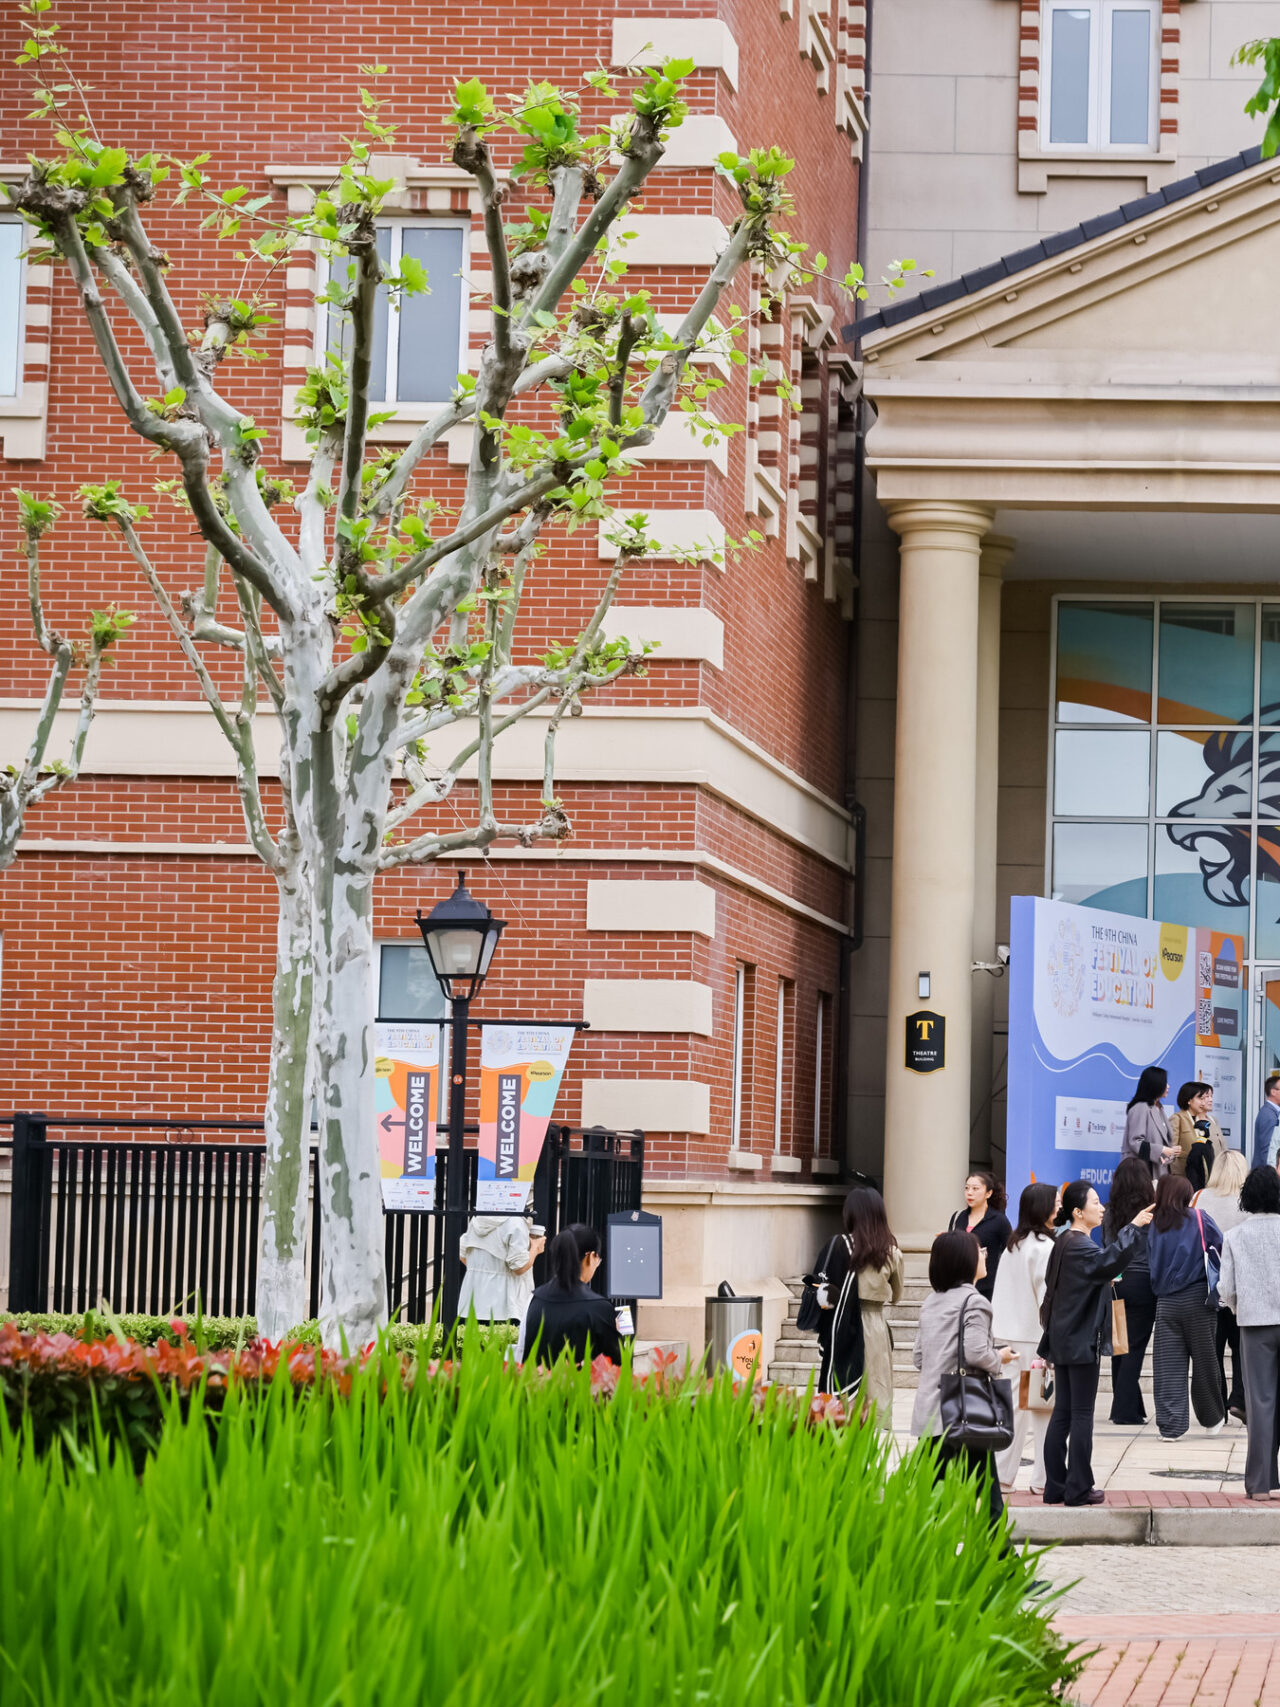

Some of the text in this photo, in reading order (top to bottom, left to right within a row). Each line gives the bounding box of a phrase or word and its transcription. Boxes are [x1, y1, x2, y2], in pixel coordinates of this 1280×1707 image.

[1092, 926, 1138, 946] THE 9TH CHINA
[1143, 952, 1157, 979] OF
[1164, 948, 1184, 963] Pearson
[1091, 973, 1154, 1009] EDUCATION
[916, 1020, 934, 1040] T
[408, 1076, 425, 1173] WELCOME
[499, 1078, 517, 1175] WELCOME
[1080, 1168, 1115, 1184] #EDUCA
